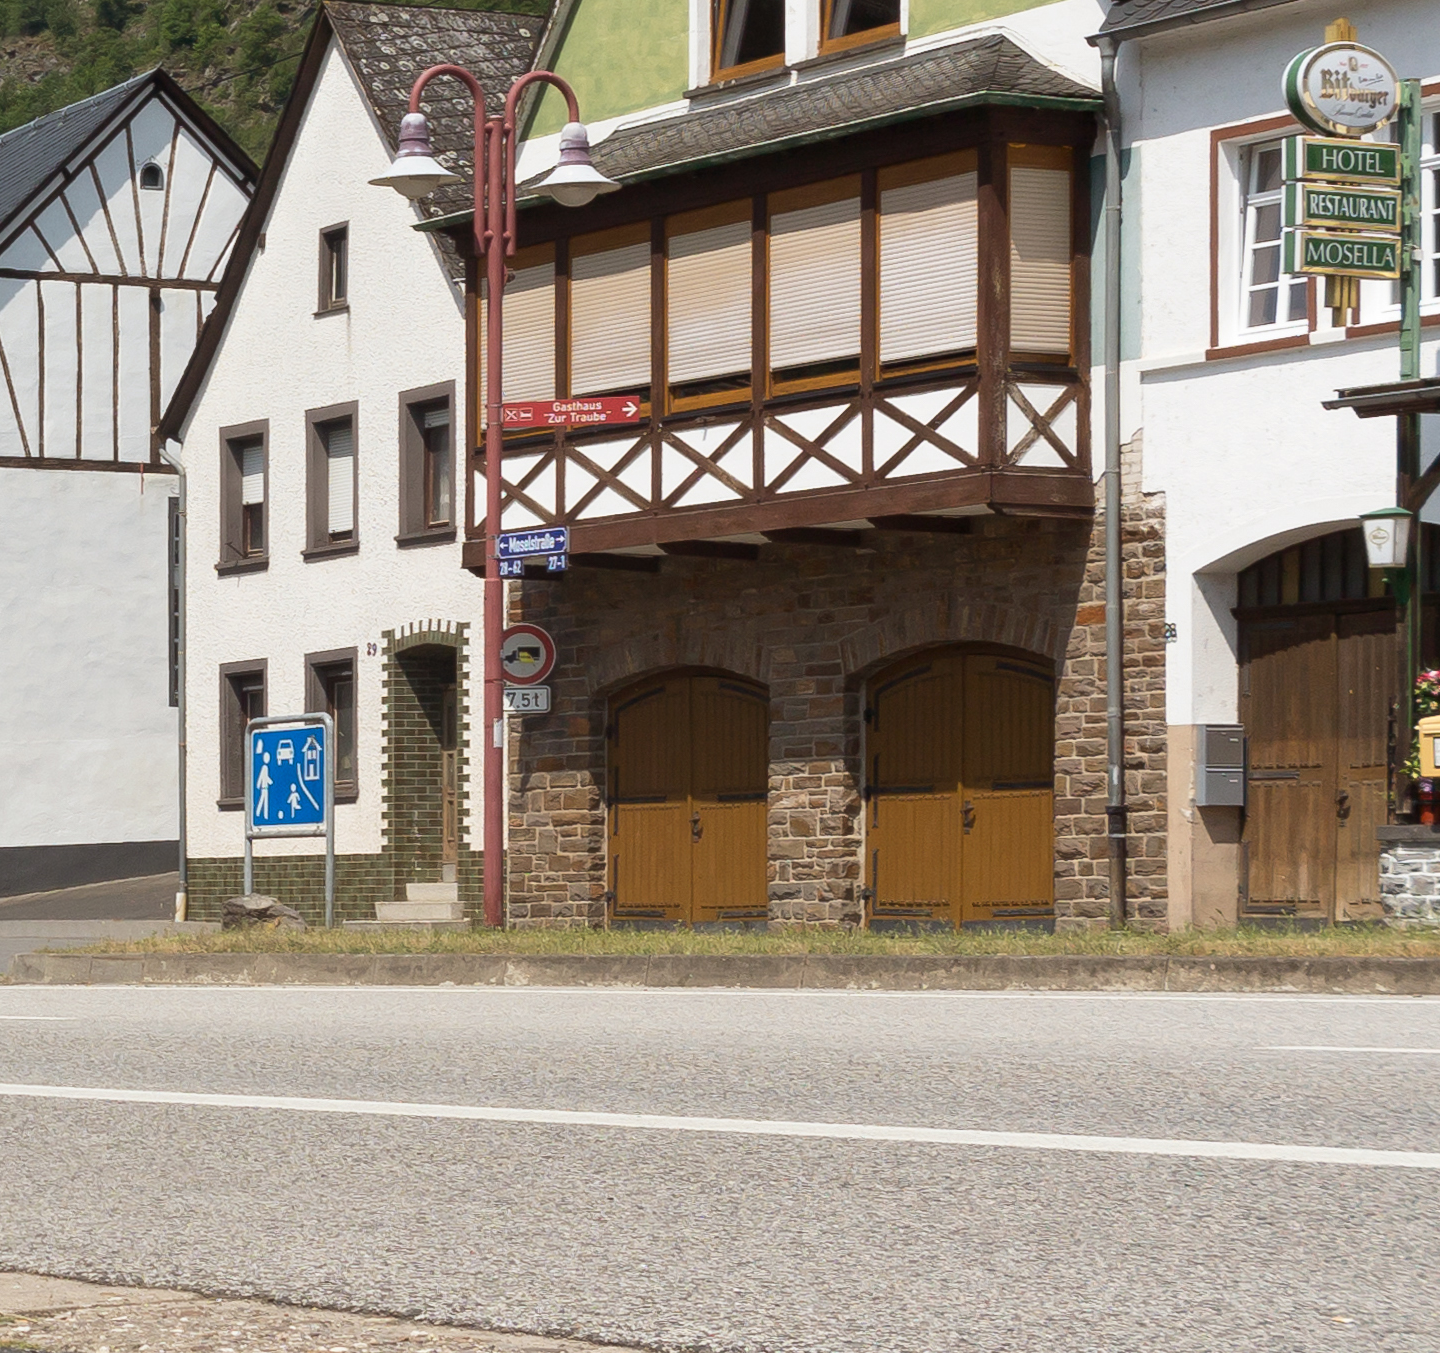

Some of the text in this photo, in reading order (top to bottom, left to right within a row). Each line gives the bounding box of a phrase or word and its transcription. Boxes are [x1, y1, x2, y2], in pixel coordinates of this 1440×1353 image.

[1322, 148, 1385, 173] HOTEL
[1309, 193, 1395, 221] RESTAURANT
[1307, 242, 1395, 268] MOSELLA
[552, 401, 602, 412] Gasthaus
[508, 533, 555, 553] Moselstraße
